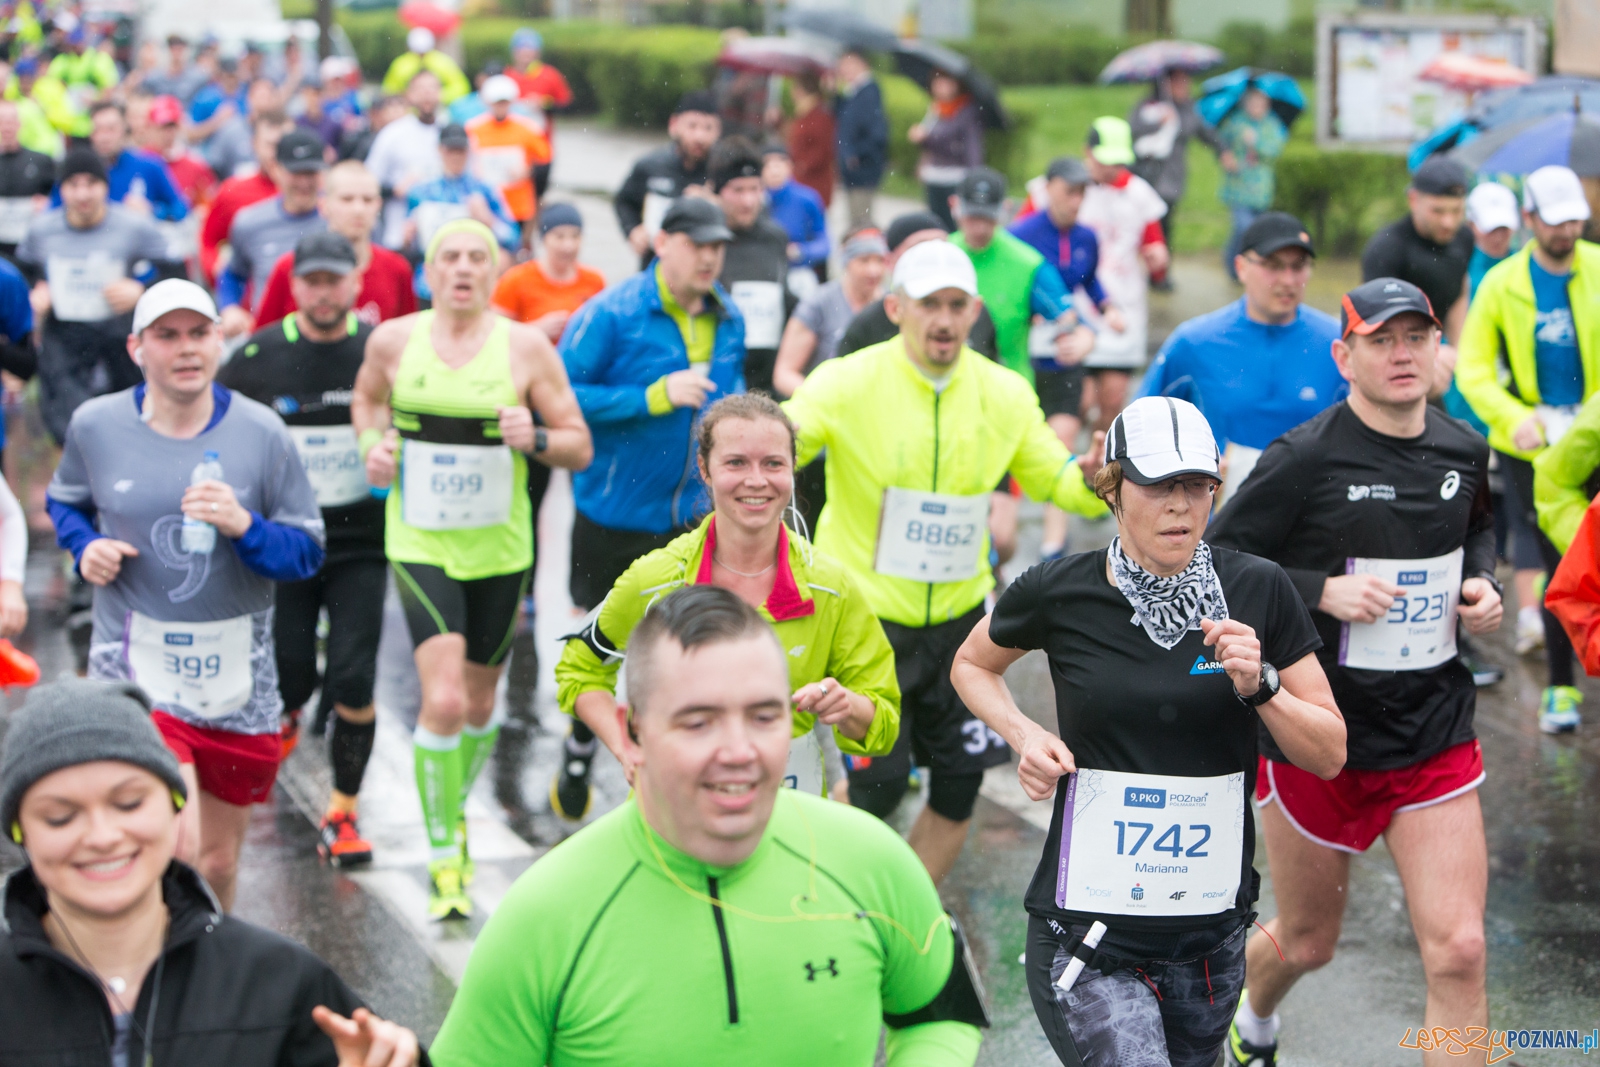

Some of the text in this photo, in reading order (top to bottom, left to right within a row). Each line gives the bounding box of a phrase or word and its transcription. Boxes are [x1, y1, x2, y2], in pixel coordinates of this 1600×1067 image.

[431, 472, 483, 495] 699
[906, 520, 975, 547] 8862
[1387, 591, 1449, 623] 3231
[164, 652, 221, 679] 399
[1197, 661, 1224, 670] GARM
[1113, 820, 1212, 858] 1742
[1135, 862, 1188, 873] Marianna
[1169, 891, 1187, 900] 4F
